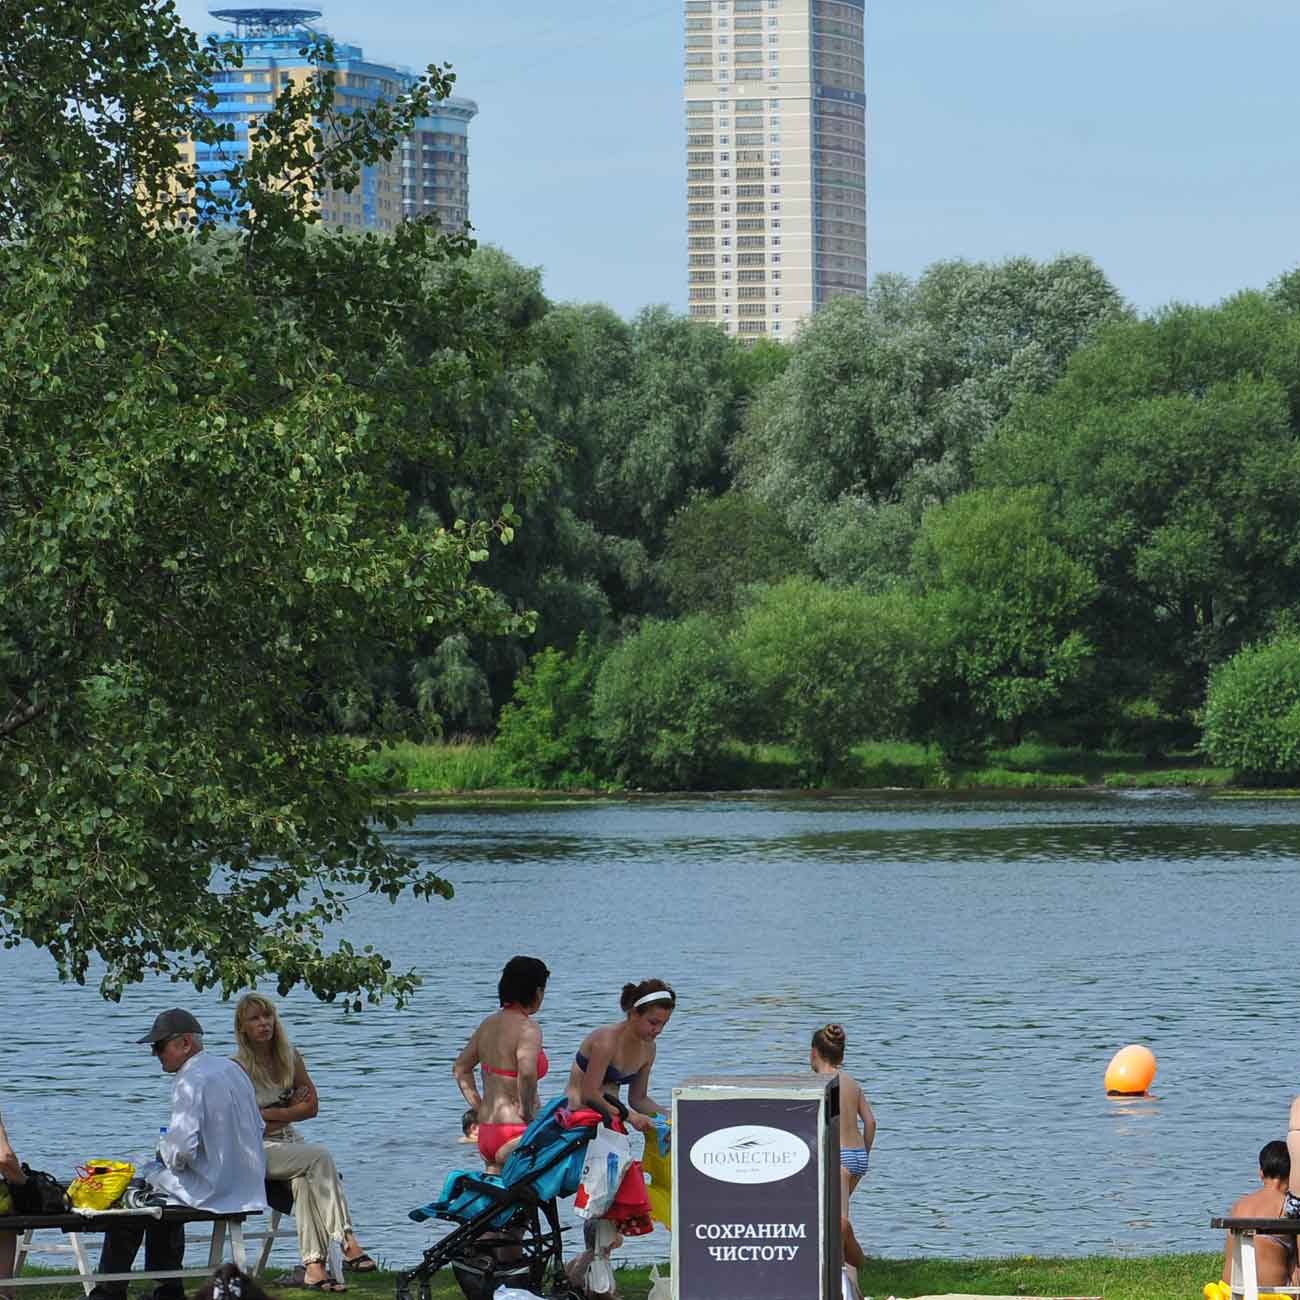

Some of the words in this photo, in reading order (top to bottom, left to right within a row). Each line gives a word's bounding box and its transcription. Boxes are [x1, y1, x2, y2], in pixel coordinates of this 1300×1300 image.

[703, 1151, 792, 1165] ПОМЕСТЬЕ
[695, 1223, 807, 1240] СОХРАНИМ
[708, 1245, 799, 1262] ЧИСТОТУ
